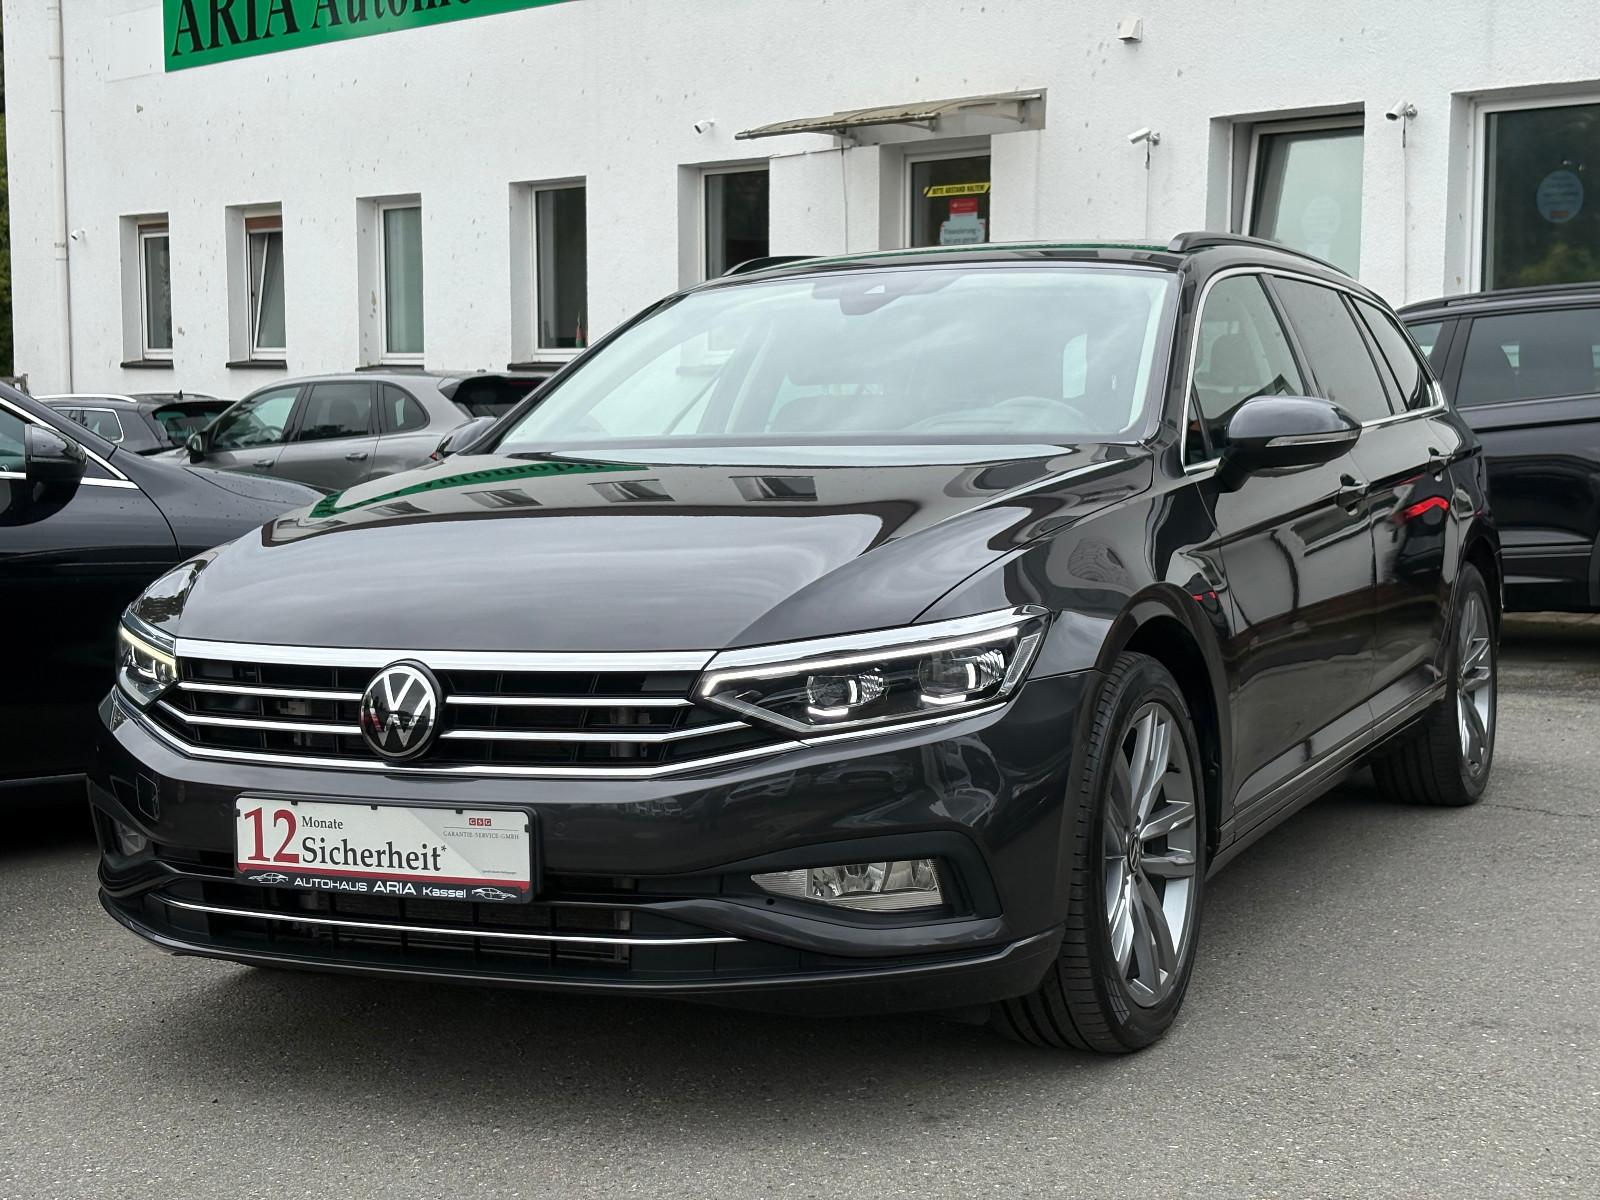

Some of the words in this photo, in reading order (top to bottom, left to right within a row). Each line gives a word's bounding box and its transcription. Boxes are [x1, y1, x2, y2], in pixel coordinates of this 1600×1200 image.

[171, 0, 301, 57] ARIA
[244, 807, 300, 864] 12
[301, 815, 344, 830] Monate
[294, 877, 368, 892] AUTOHAUS
[373, 881, 417, 896] ARIA
[422, 886, 467, 899] Kassel
